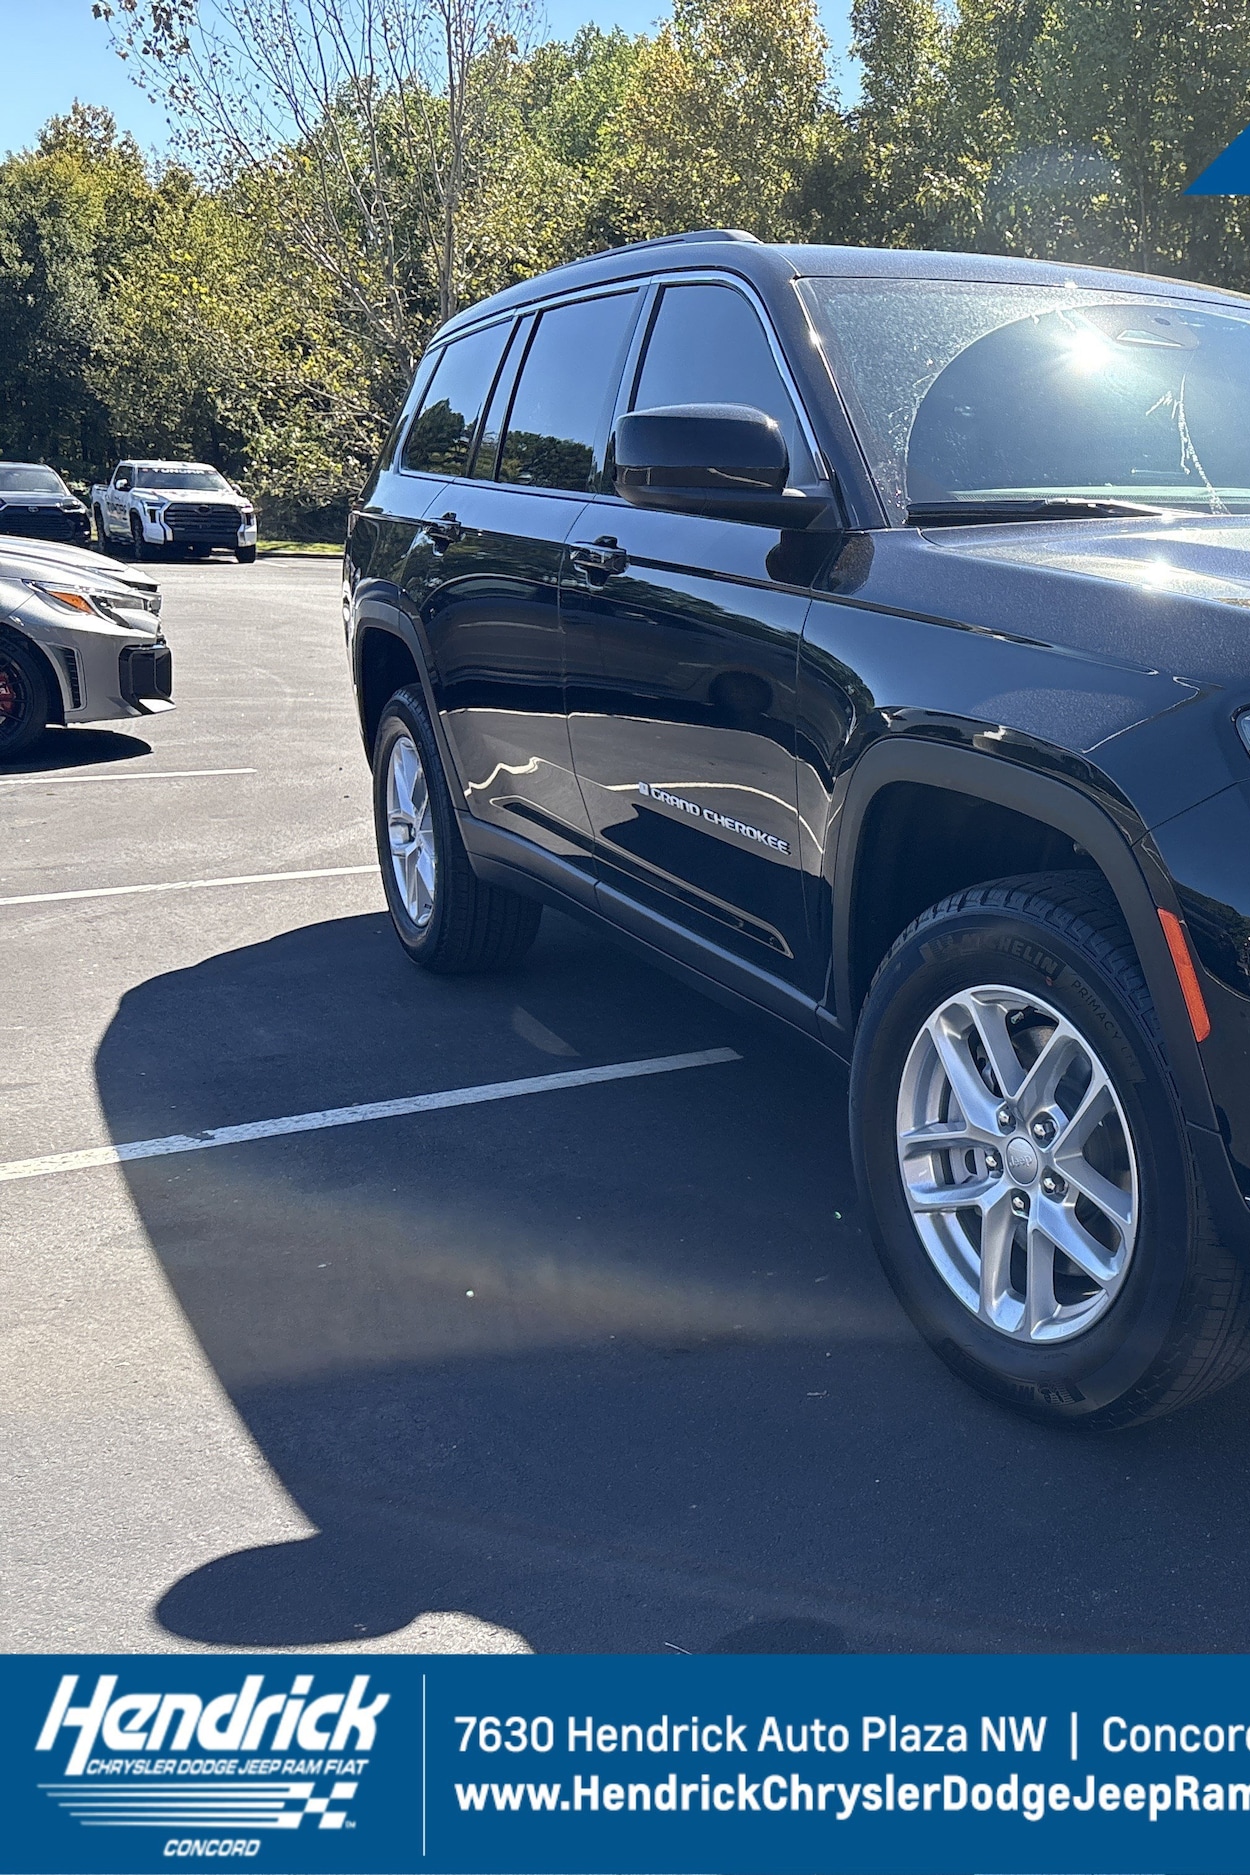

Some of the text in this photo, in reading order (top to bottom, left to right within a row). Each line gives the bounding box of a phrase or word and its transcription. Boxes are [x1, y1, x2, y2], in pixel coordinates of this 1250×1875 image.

[651, 788, 791, 856] GRAND CHEROKEE
[1071, 979, 1122, 1040] PRIMACY
[1009, 1155, 1033, 1168] Jeep
